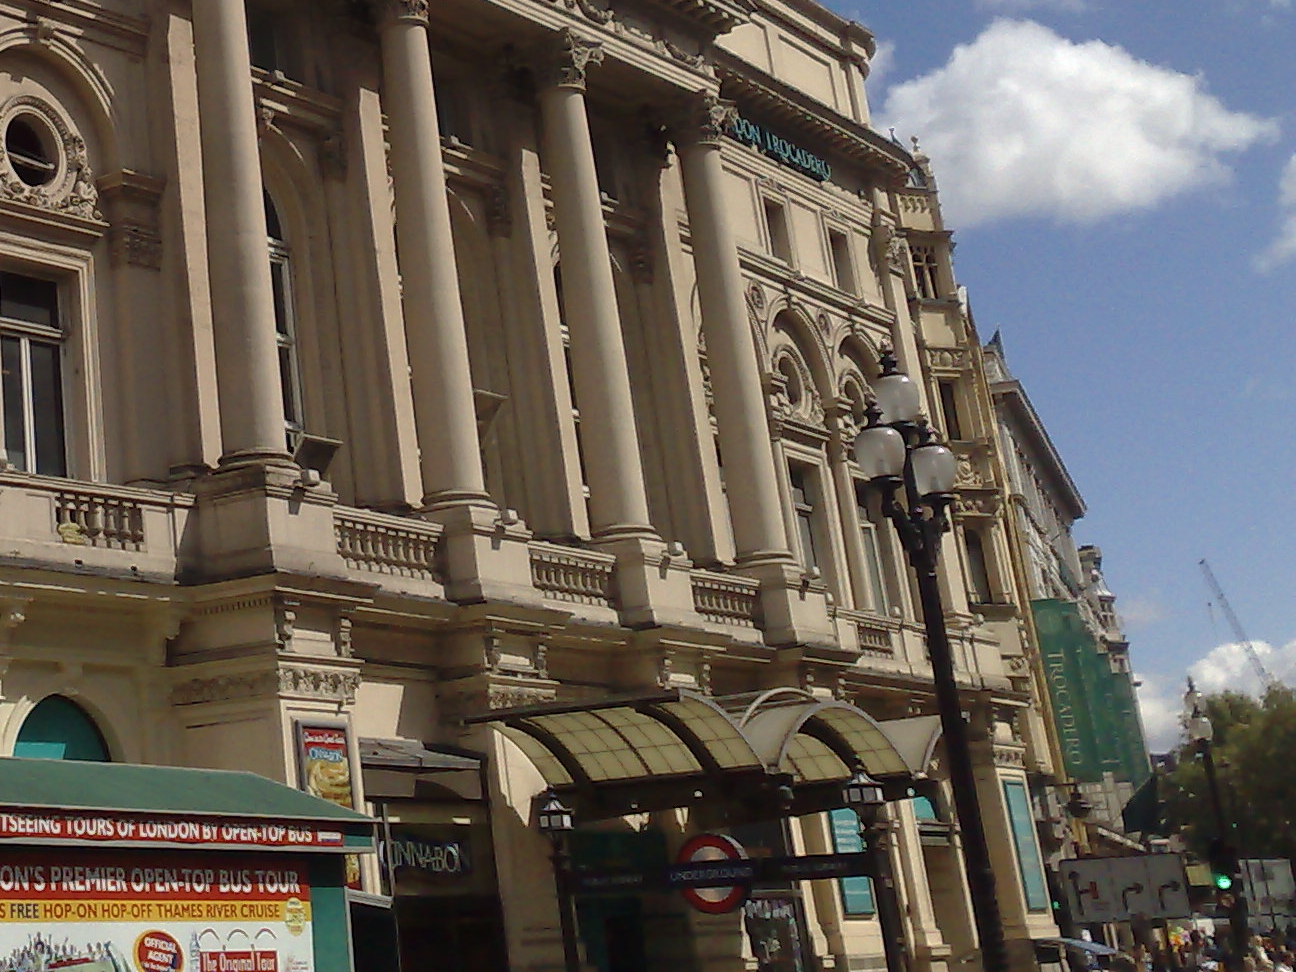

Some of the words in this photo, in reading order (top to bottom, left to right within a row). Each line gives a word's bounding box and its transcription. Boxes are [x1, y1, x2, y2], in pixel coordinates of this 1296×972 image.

[65, 816, 115, 837] TOURS
[117, 820, 135, 838] OF
[139, 820, 200, 839] LONDON
[202, 822, 219, 841] BY
[222, 823, 287, 843] OPEN-TOP
[288, 826, 313, 844] BUS
[51, 866, 129, 893] PREMIER
[131, 867, 214, 894] OPEN-TOP
[219, 870, 253, 894] BUS
[256, 870, 301, 895] TOUR
[10, 903, 40, 919] FREE
[44, 903, 98, 919] HOP-ON
[102, 903, 153, 919] HOP-OFF
[157, 903, 203, 919] THAMES
[206, 903, 238, 918] RIVER
[241, 903, 280, 918] CRUISE
